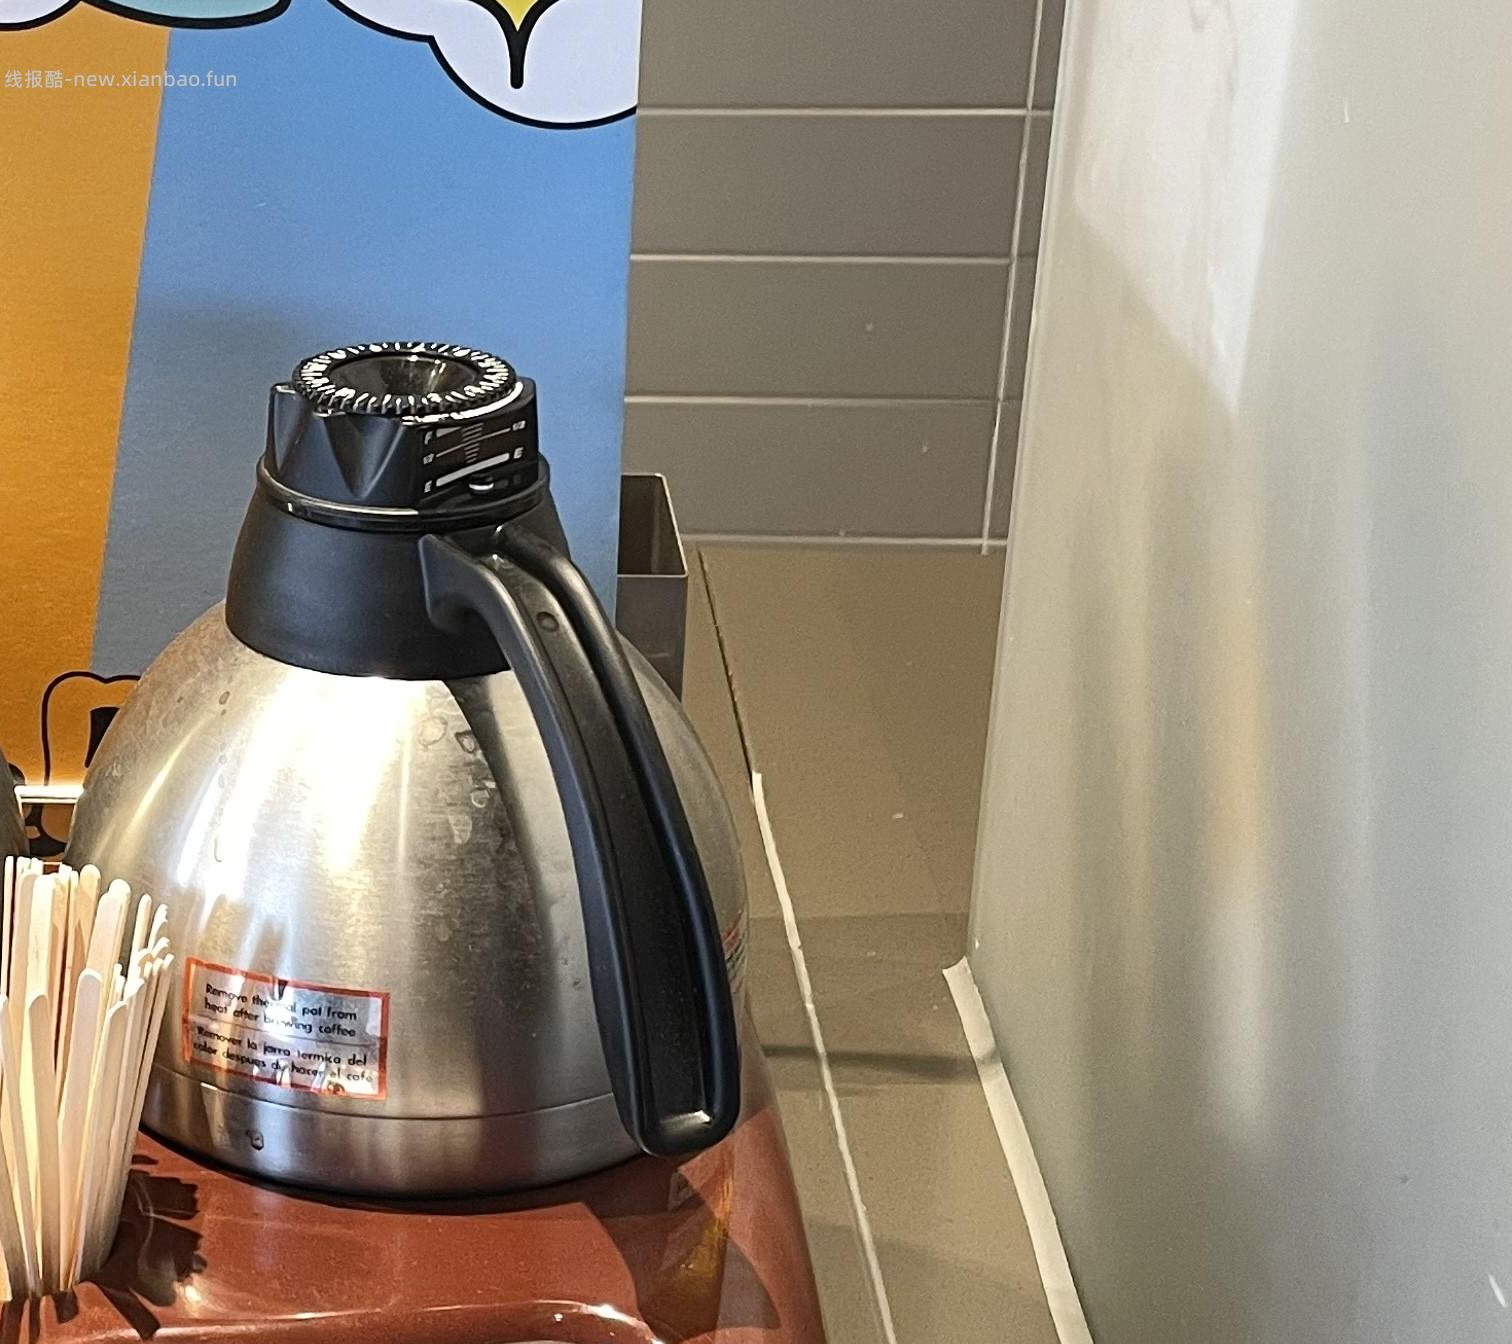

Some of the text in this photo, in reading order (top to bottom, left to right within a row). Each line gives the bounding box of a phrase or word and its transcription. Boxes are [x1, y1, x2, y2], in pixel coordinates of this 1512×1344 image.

[204, 997, 228, 1014] heat
[233, 1007, 259, 1021] after
[318, 1023, 356, 1037] coffee
[206, 983, 357, 1020] Remove theal pot from
[196, 1025, 242, 1046] Remover
[247, 1037, 258, 1051] la
[263, 1041, 291, 1057] jarra
[347, 1052, 368, 1066] del
